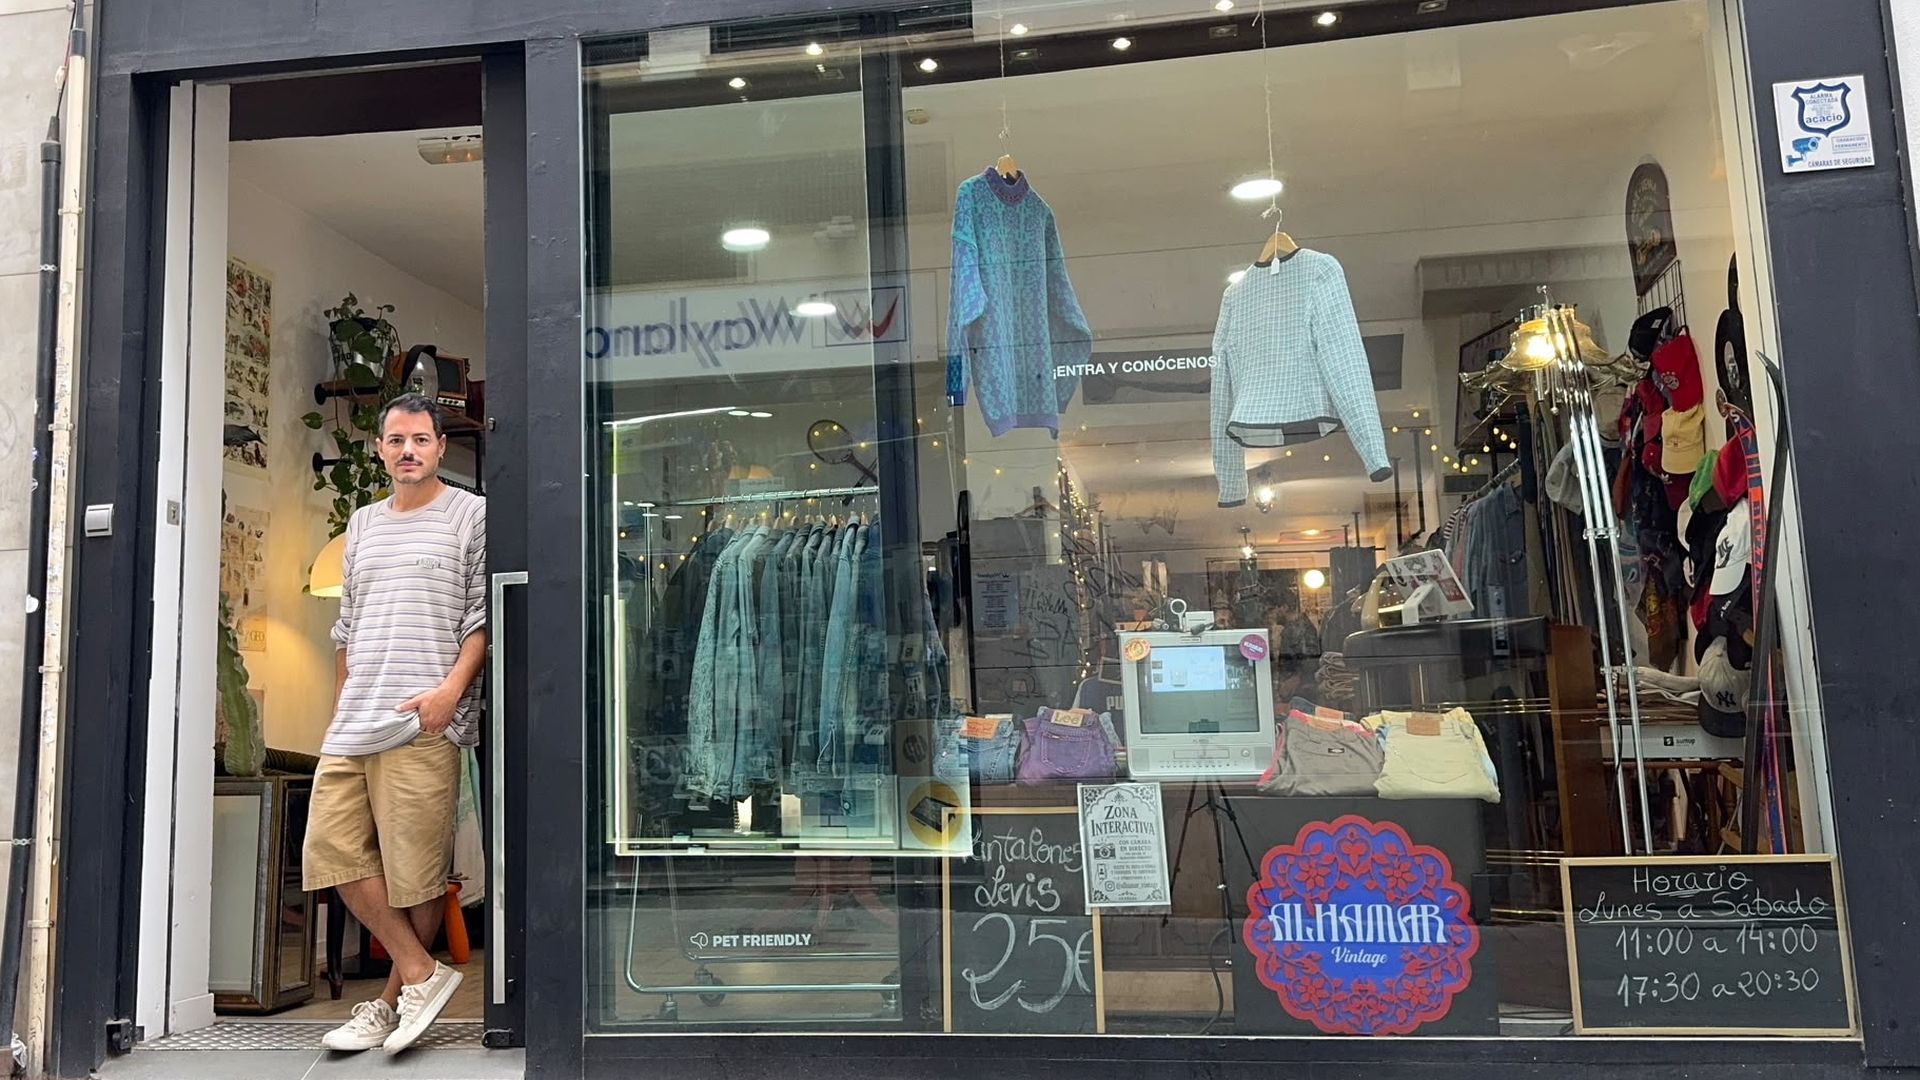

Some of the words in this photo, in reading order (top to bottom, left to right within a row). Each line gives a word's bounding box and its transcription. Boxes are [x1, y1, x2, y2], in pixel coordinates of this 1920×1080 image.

[1805, 114, 1843, 123] acacio
[1053, 362, 1106, 380] ¡ENTRA
[1107, 361, 1119, 374] Y
[1104, 805, 1138, 820] ZONA
[1091, 820, 1155, 837] INTERACTIVA
[975, 865, 1060, 912] Levis
[1633, 865, 1753, 893] Horario
[1579, 891, 1663, 922] Lunes
[1677, 903, 1702, 919] a
[1711, 887, 1831, 918] Sábado
[1268, 903, 1449, 943] ALHAMAR
[712, 935, 739, 947] PET
[742, 933, 812, 947] FRIENDLY
[1615, 925, 1694, 960] 11:00
[1702, 937, 1729, 954] a
[1735, 923, 1818, 955] 14:00
[1331, 946, 1389, 968] Vintage
[1617, 972, 1700, 1007] 17:30
[1711, 982, 1736, 998] a
[1738, 968, 1820, 999] 20:30
